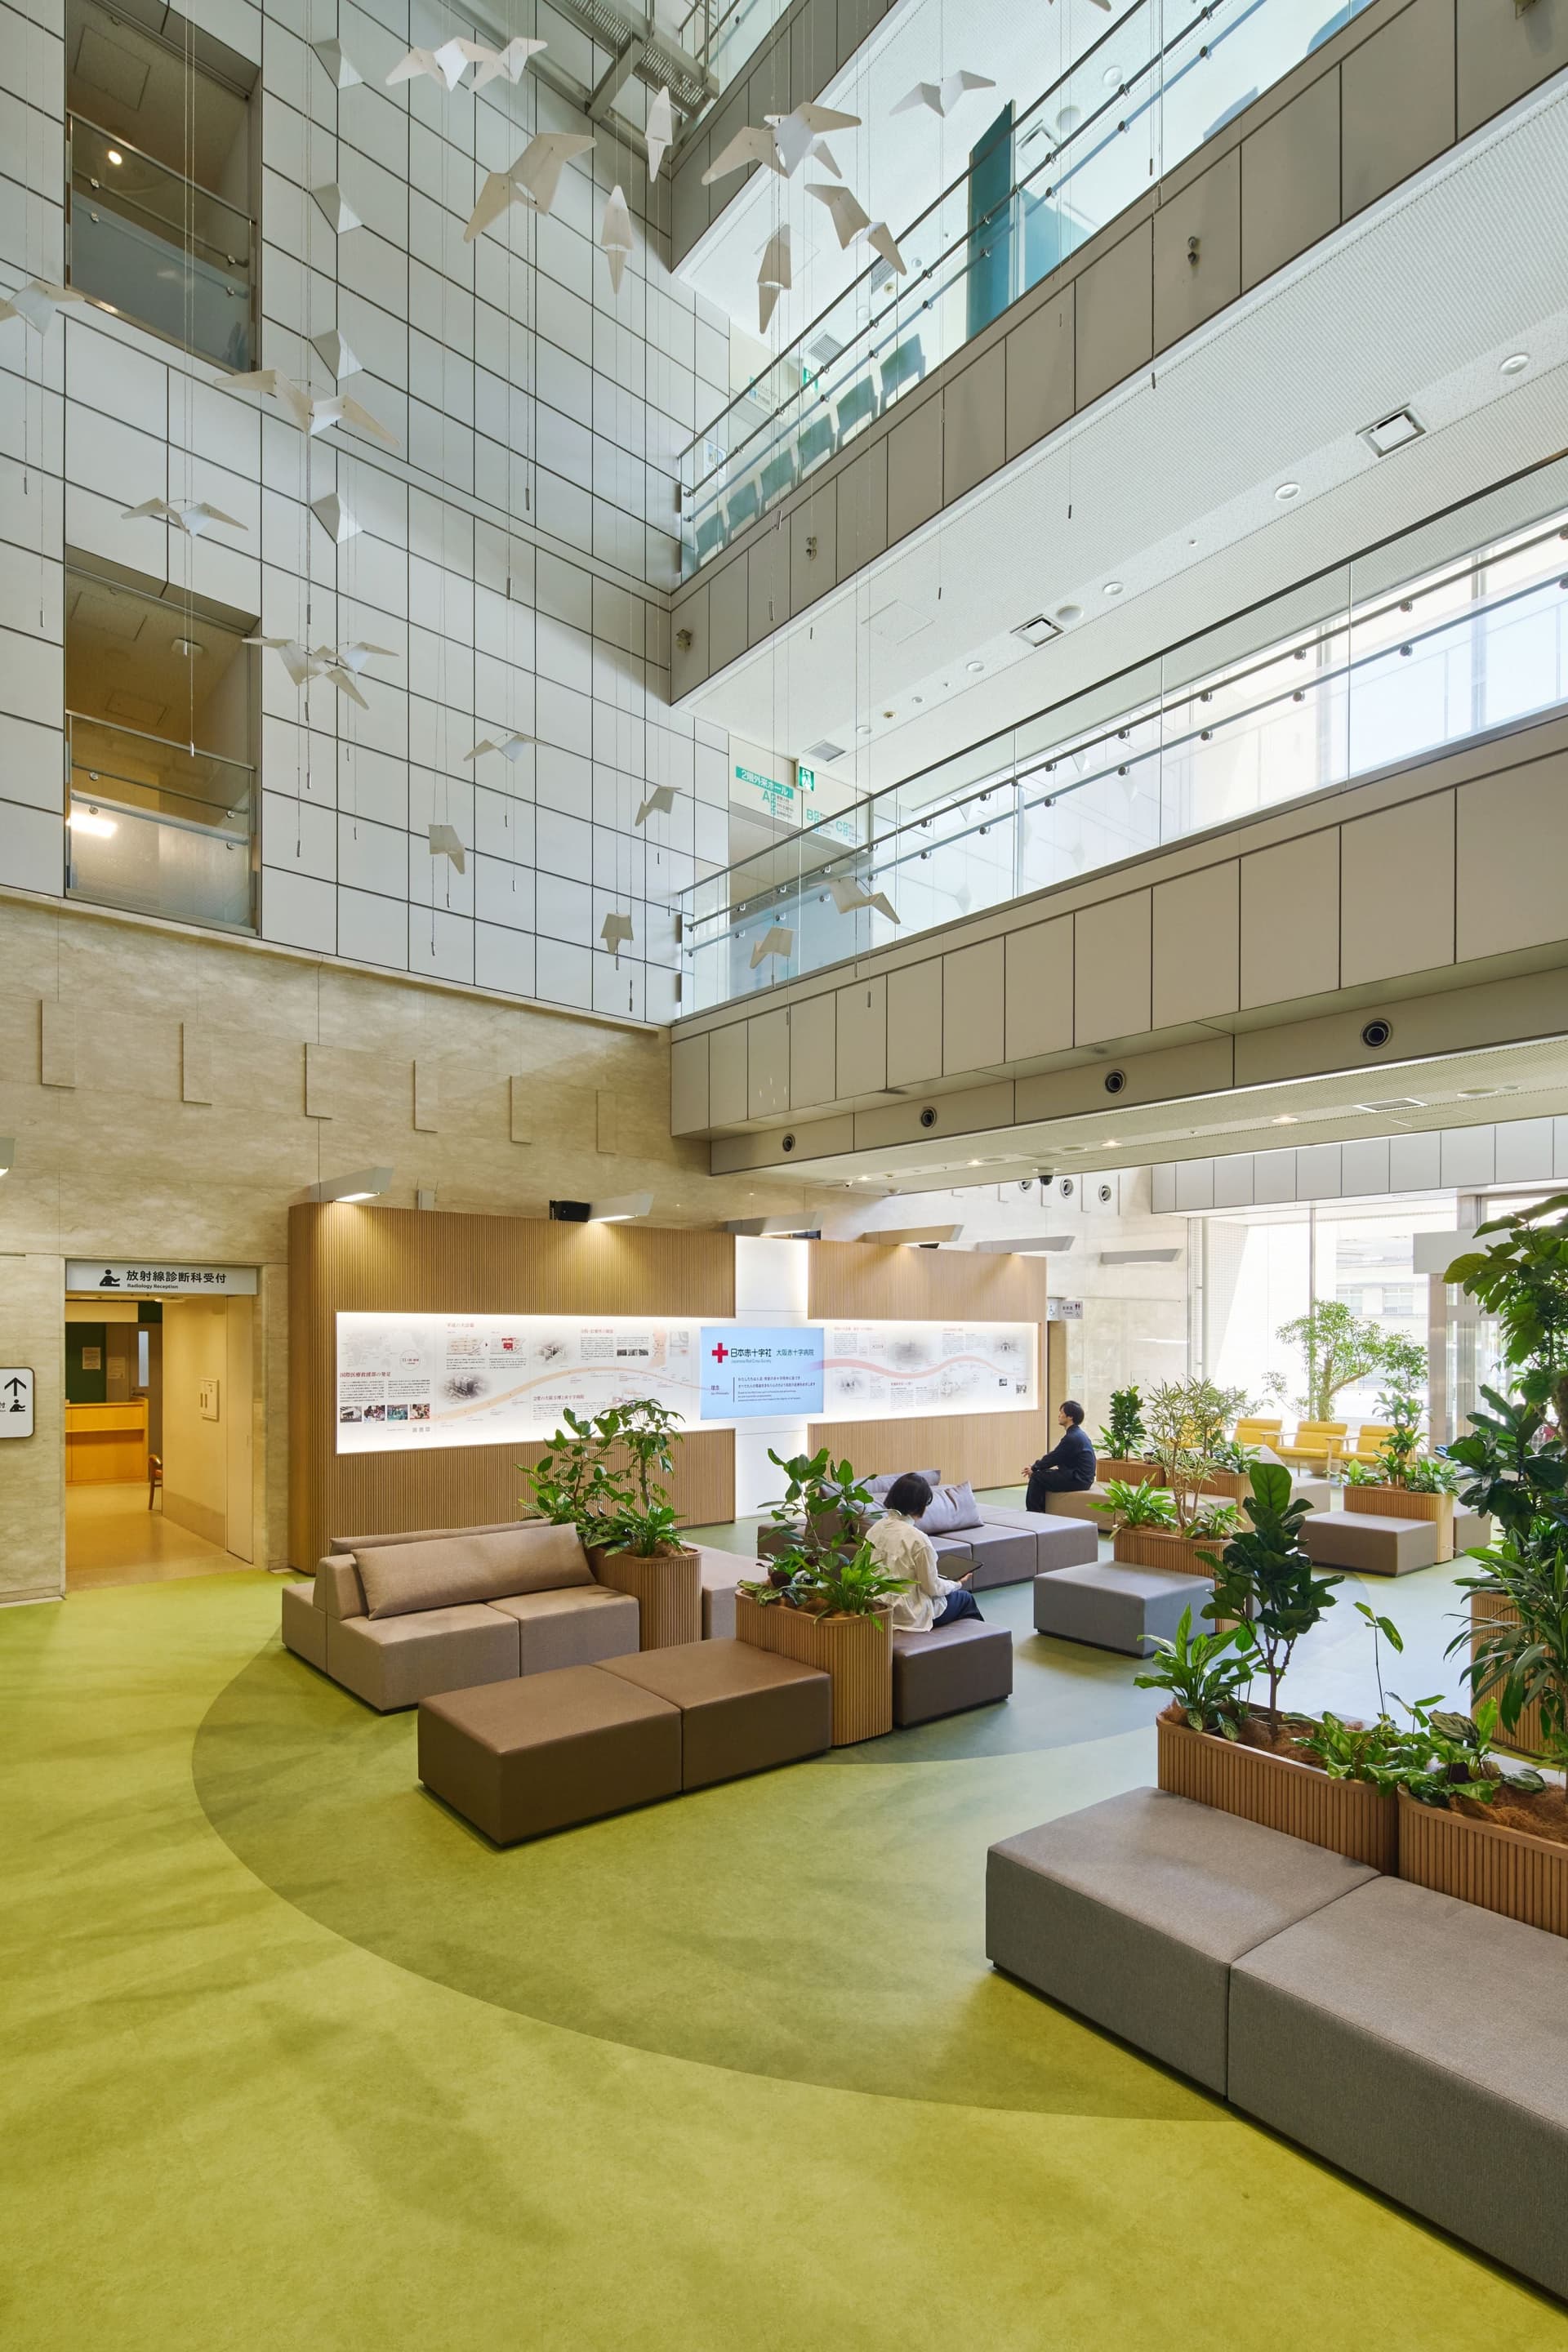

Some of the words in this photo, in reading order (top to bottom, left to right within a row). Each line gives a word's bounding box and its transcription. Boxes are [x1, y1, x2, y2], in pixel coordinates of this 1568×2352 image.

[762, 791, 770, 803] A
[806, 808, 814, 821] B
[126, 1270, 227, 1284] 放射線診断科受付
[730, 1348, 772, 1358] 日本赤十字社
